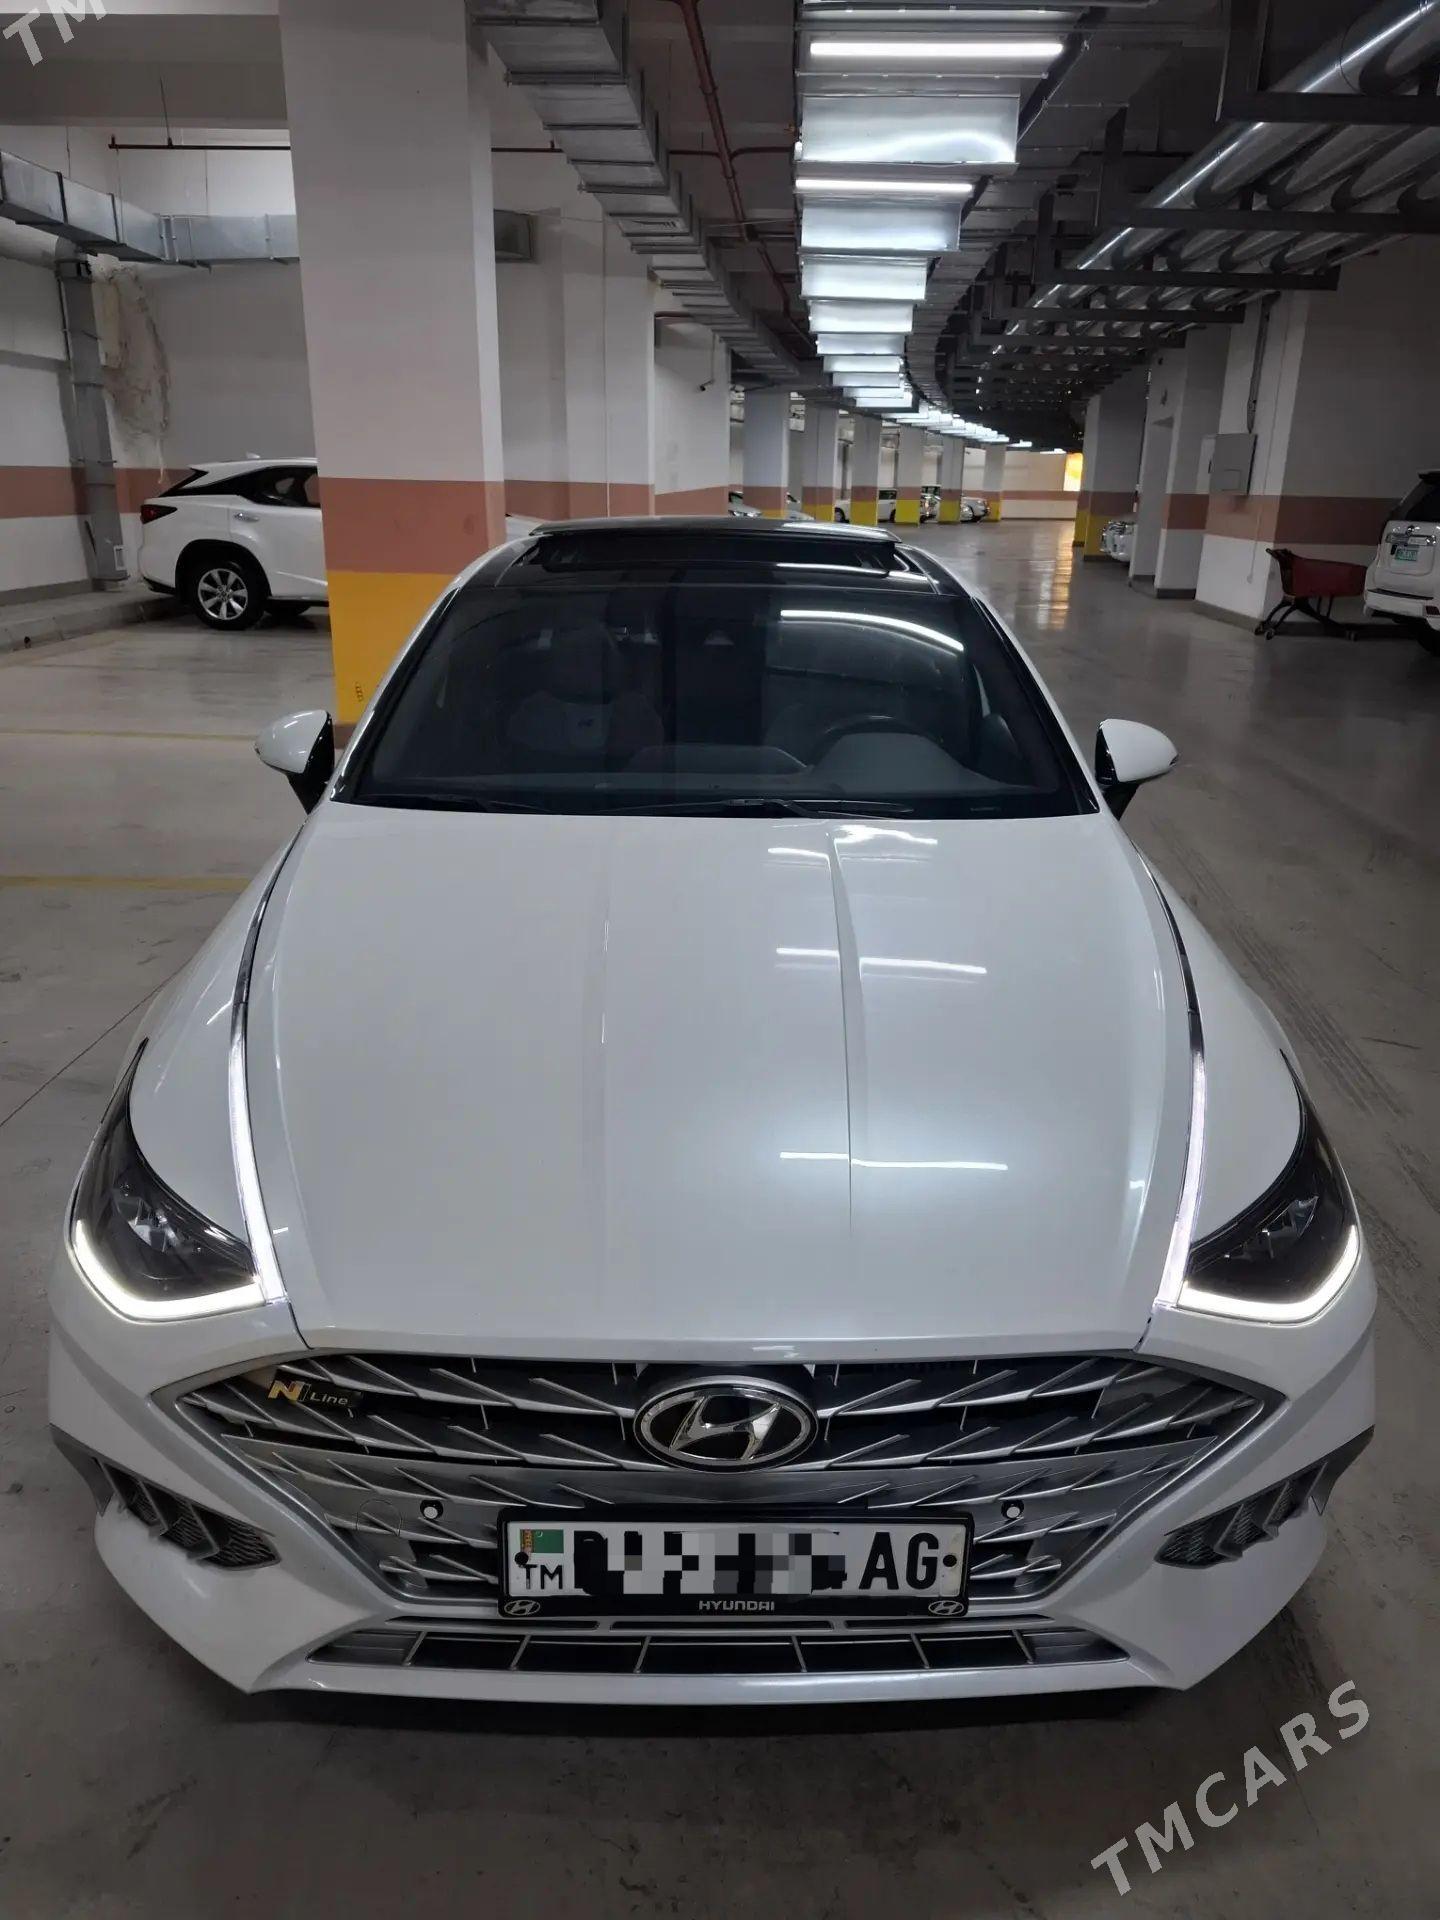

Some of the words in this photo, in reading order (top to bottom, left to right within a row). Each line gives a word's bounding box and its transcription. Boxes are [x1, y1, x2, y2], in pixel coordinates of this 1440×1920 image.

[310, 1391, 349, 1405] Line
[858, 1531, 940, 1591] AG
[518, 1563, 563, 1590] TM
[699, 1600, 775, 1611] HYUNDAI
